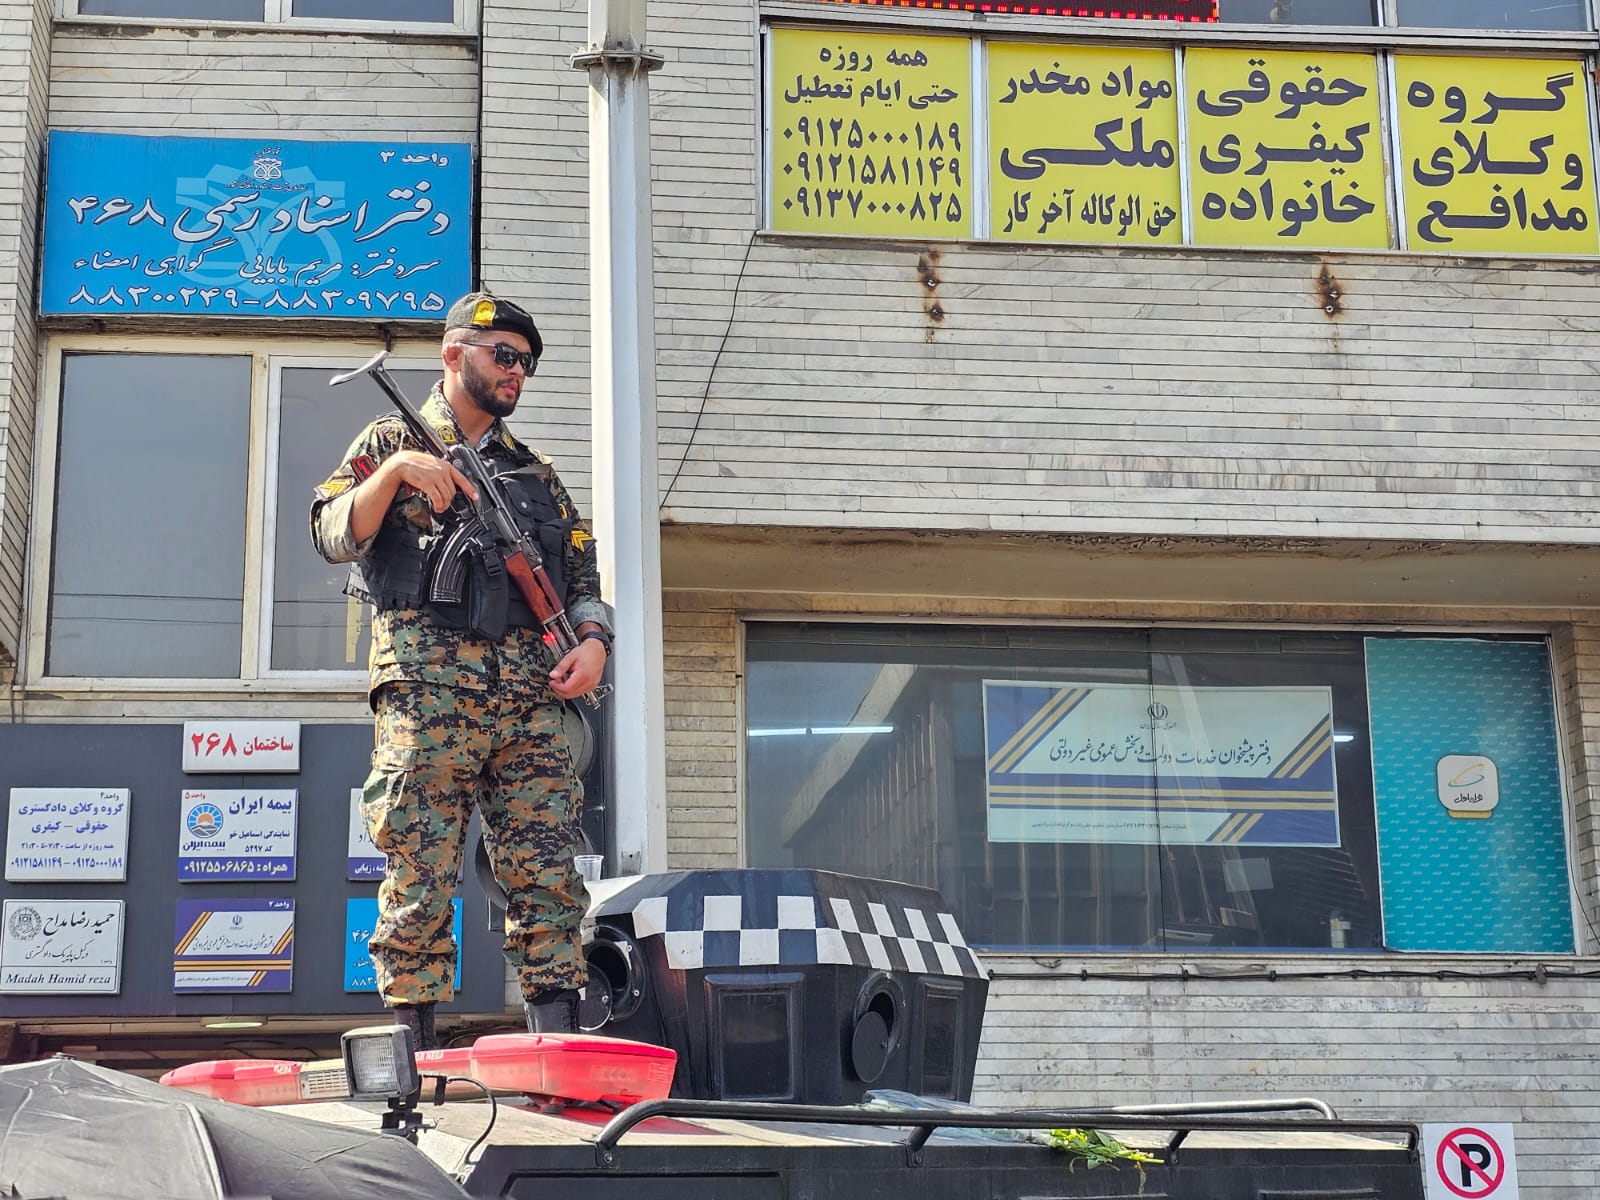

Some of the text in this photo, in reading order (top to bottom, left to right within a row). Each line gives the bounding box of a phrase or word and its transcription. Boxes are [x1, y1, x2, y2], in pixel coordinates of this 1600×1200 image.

[820, 46, 928, 72] همه روزه
[784, 74, 959, 109] حتی ایام تعطیل
[999, 61, 1173, 109] مواد مخدر
[1196, 58, 1367, 119] حقوقی
[1407, 71, 1574, 124] گروه
[783, 116, 961, 152] ۰۹۱۲۵۰۰۰۱۸۹
[1000, 117, 1175, 180] ملکی
[1199, 121, 1370, 177] کیفری
[379, 150, 449, 167] واحد ۳
[783, 152, 961, 187] ۰۹۱۲۱۵۸۱۱۴۹
[1412, 129, 1583, 191] وکلای
[68, 180, 450, 243] دفتر اسناد رسمی ۴۶۸
[783, 187, 962, 222] ۰۹۱۳۷۰۰۰۸۲۵
[1003, 188, 1177, 237] حق الوکاله آخر کار
[1202, 178, 1376, 237] خانواده
[1417, 184, 1588, 243] مدافع
[74, 251, 139, 270] امضاء
[144, 236, 238, 276] گواهی
[294, 259, 343, 286] مریم
[191, 732, 294, 757] ساختمان ۲۶۸
[18, 802, 124, 815] گروه وکلای دادگستری
[184, 791, 206, 800] واحد ۵
[229, 796, 292, 815] بیمه ایران
[31, 821, 62, 833] کیفری
[76, 820, 109, 833] حقوقی
[239, 830, 263, 840] اسماعیل
[263, 830, 290, 840] نمایندگی
[274, 901, 290, 909] واحد
[43, 910, 115, 936] حمید رضا مداح
[6, 973, 111, 984] Madah Hamid reza
